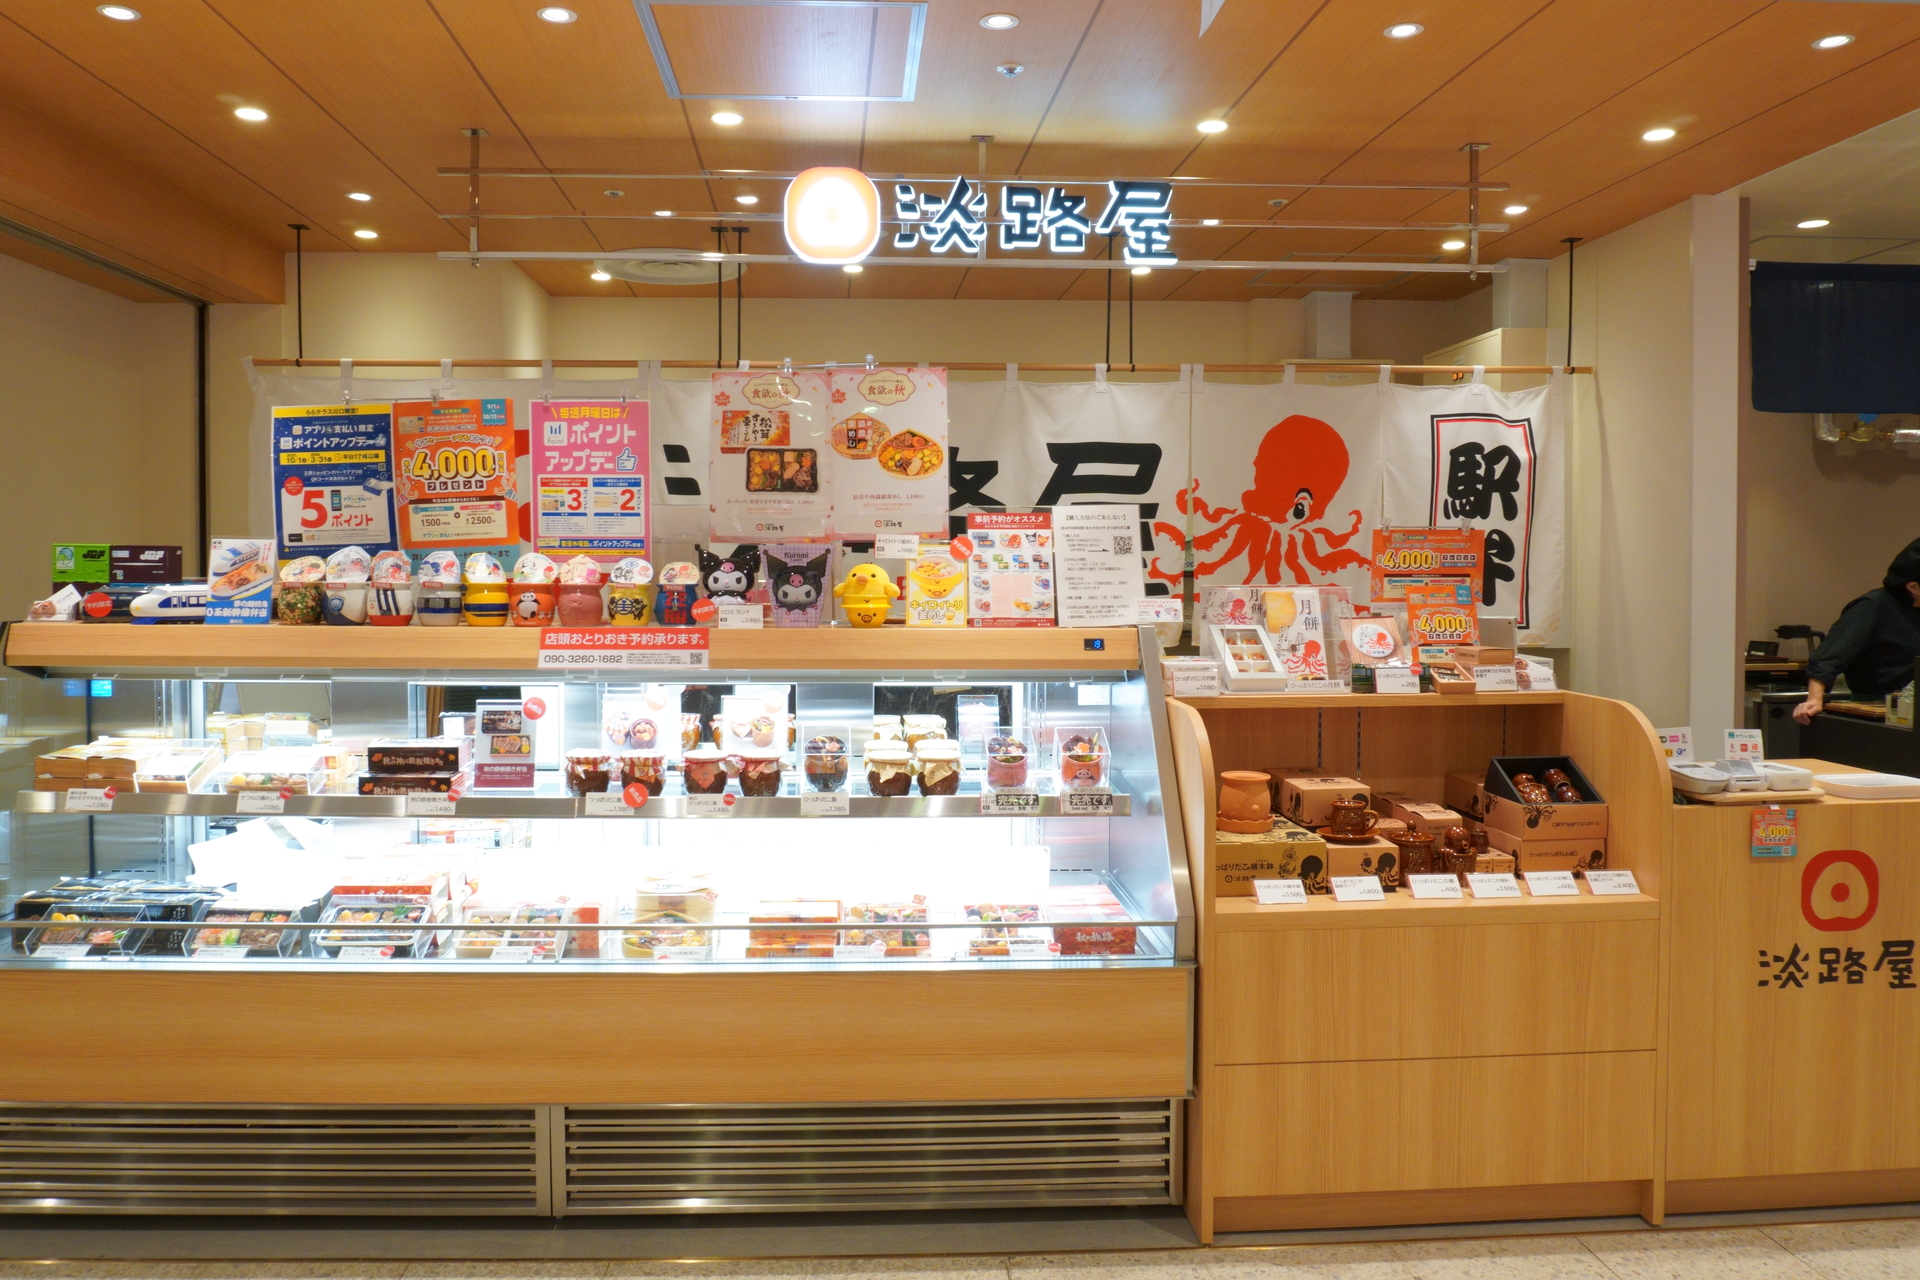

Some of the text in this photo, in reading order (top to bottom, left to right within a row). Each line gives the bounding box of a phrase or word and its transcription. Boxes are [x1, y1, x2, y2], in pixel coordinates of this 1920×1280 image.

[894, 175, 1178, 265] 淡路屋
[868, 384, 905, 396] 食欲の秋
[559, 406, 621, 419] 毎週月曜日は
[570, 421, 637, 444] ポイント
[412, 448, 496, 480] 4,000
[545, 449, 615, 472] アップデー
[427, 481, 485, 491] プレゼント
[567, 488, 582, 511] 3
[619, 488, 636, 511] 2
[300, 489, 329, 529] 5
[331, 513, 374, 528] ポイント
[974, 514, 1044, 523] 事前予約がオススメ
[1383, 550, 1434, 570] 4,000
[909, 599, 963, 610] キイロイトリ
[1249, 588, 1264, 615] 月餅
[917, 609, 945, 621] 釜めし
[1299, 599, 1320, 631] 月餅
[1419, 615, 1467, 634] 4,000
[544, 632, 705, 646] 店頭おとりおき予約承ります。
[544, 654, 623, 664] 090-3260-1682
[1290, 681, 1341, 689] ひっぱりだこの月餅
[997, 794, 1039, 806] 完売です。
[1071, 794, 1112, 806] 完売です。
[1757, 939, 1918, 990] 淡路屋
